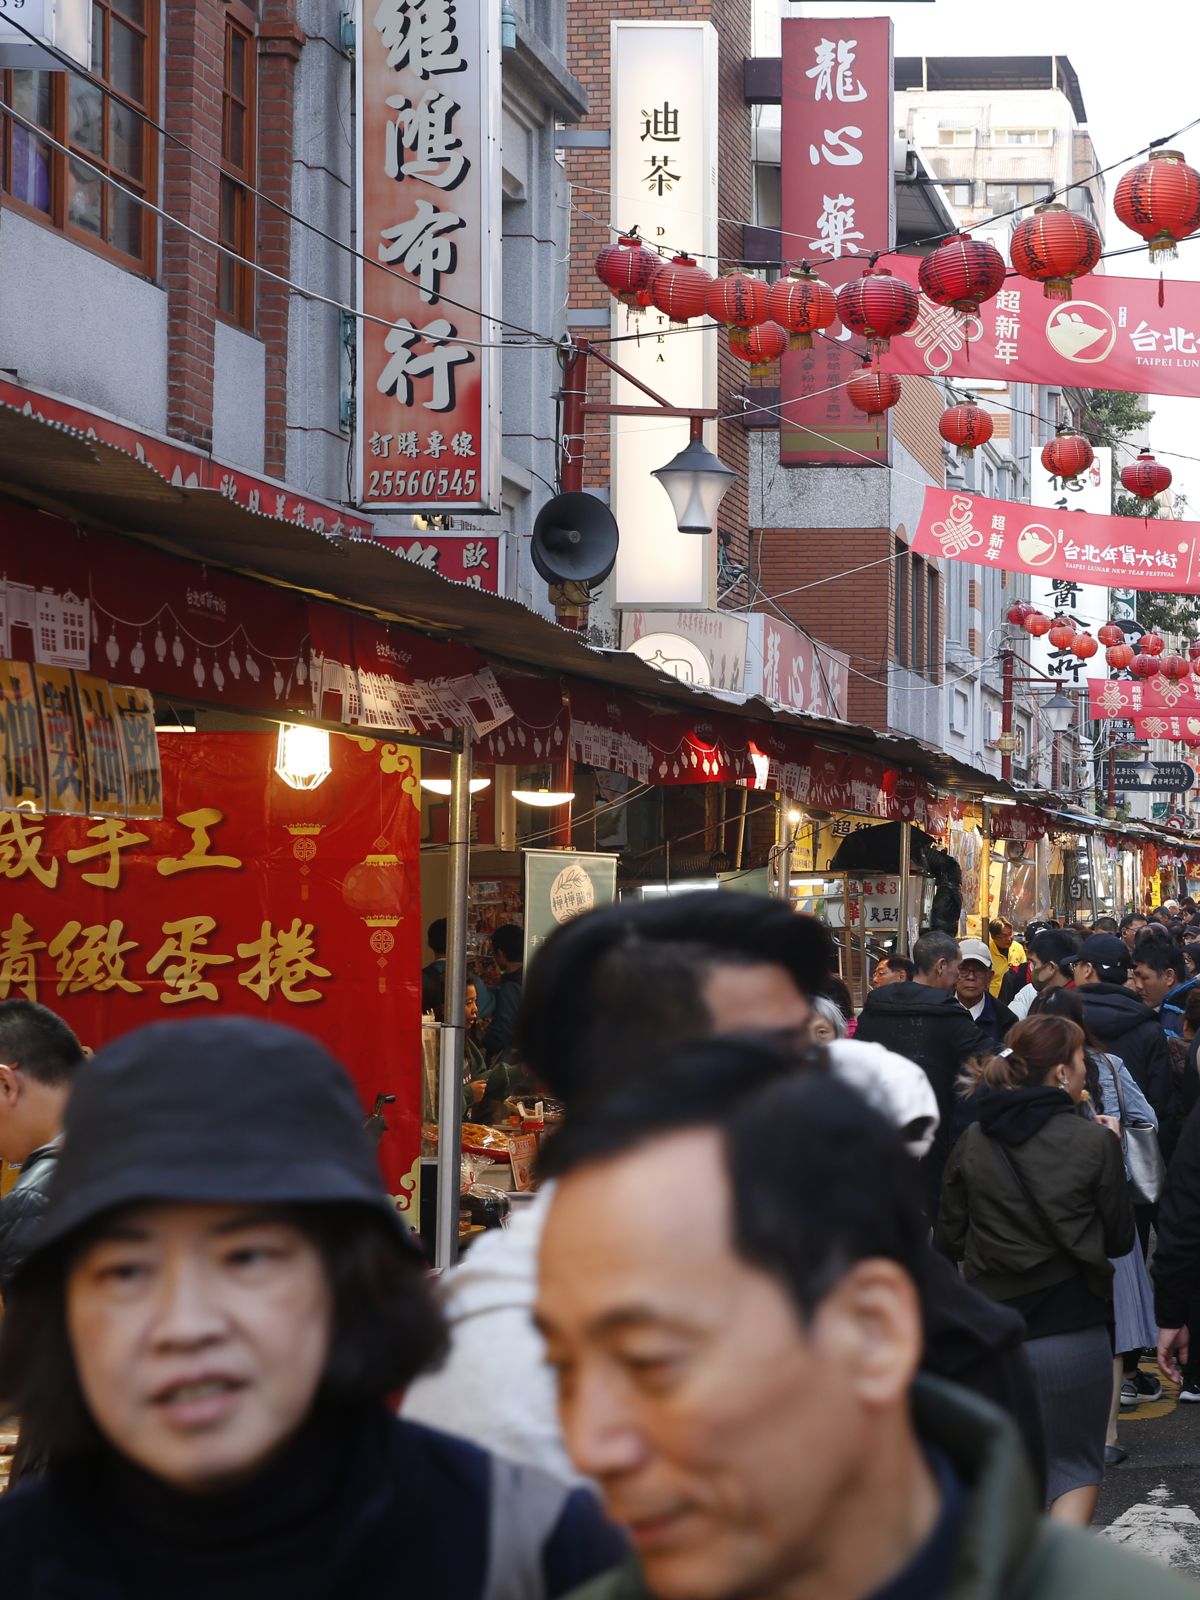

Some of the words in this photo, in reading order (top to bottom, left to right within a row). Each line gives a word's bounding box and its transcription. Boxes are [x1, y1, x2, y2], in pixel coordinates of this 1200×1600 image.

[639, 100, 682, 198] 迪茶
[804, 38, 868, 341] 龍心藥
[373, 0, 478, 413] 維鴻布行
[1135, 356, 1172, 367] TAIPEI
[369, 430, 477, 459] 訂購專線
[368, 469, 477, 497] 25560545
[1063, 540, 1178, 569] 台北年貨大街
[1065, 562, 1086, 571] TAIPEI
[1087, 565, 1110, 574] LUNAR
[1111, 567, 1128, 575] NEW
[1145, 570, 1175, 578] FESTIVAL
